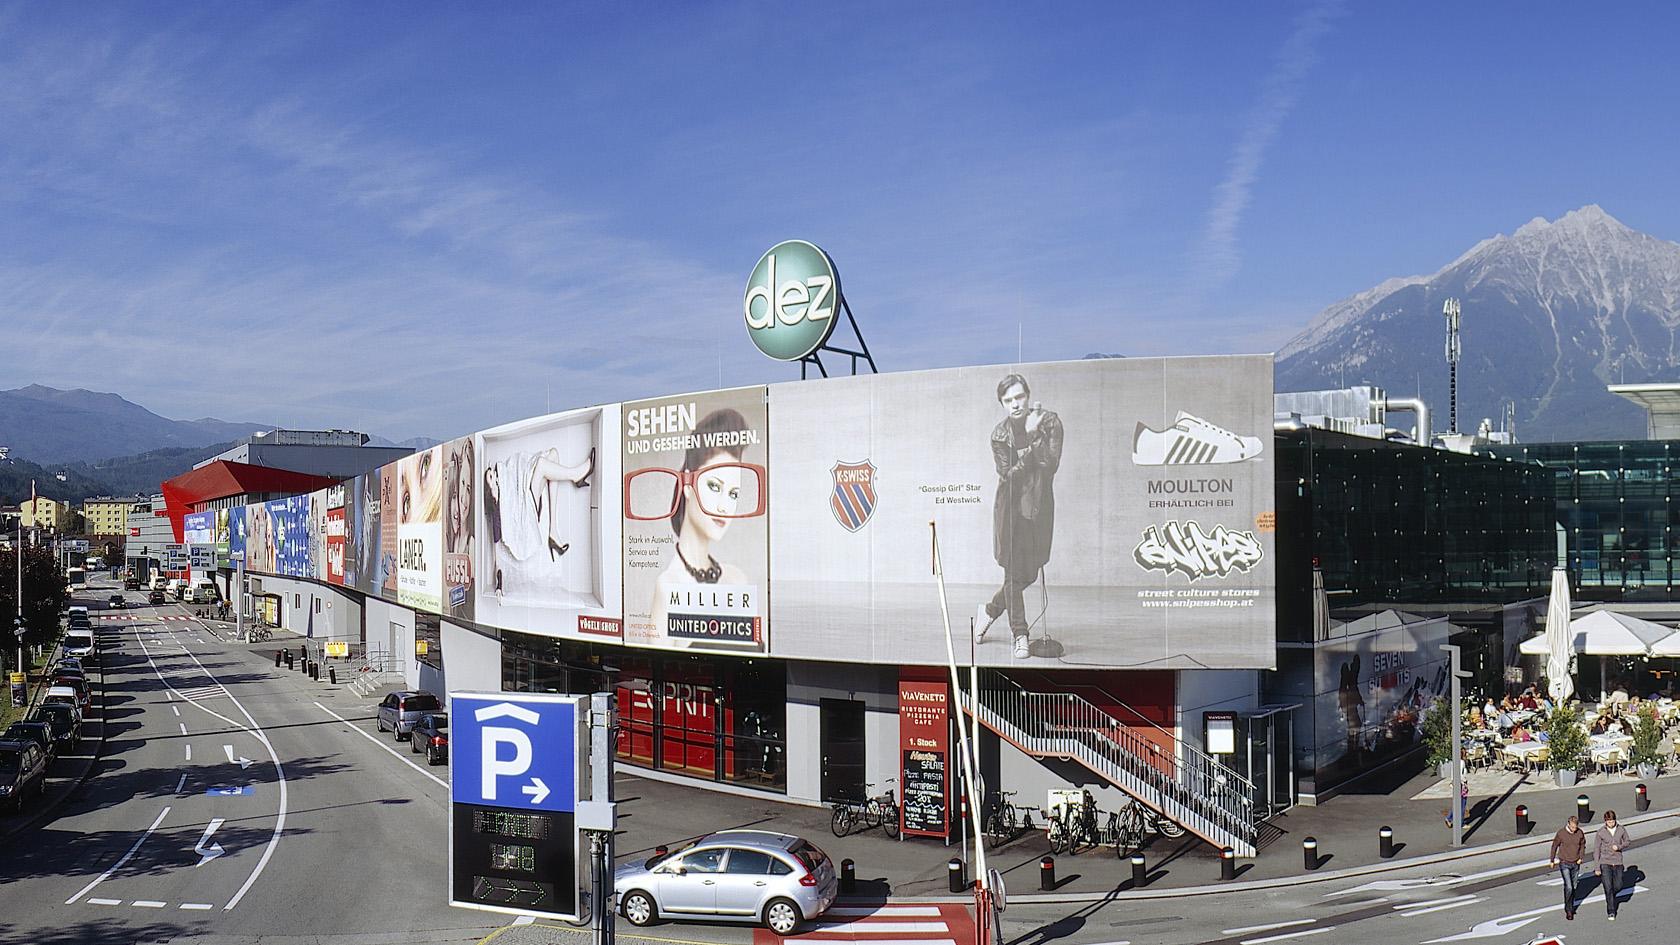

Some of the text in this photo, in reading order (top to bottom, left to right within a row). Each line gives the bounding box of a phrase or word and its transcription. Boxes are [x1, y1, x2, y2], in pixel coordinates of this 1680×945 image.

[745, 254, 832, 330] dez
[627, 402, 697, 437] SEHEN
[628, 430, 760, 454] UND GESEHEN WERDEN.
[965, 483, 981, 492] Star
[1147, 479, 1233, 494] MOULTON
[935, 496, 982, 504] Ed Westwick
[1149, 499, 1234, 508] ERHÄLTLICH BEI
[628, 534, 644, 544] Stark
[628, 546, 660, 556] Service und
[1137, 588, 1260, 598] street culture stores
[670, 592, 750, 608] MILLER
[1142, 598, 1254, 608] www.snipesshop.at
[601, 621, 619, 633] SHOES
[1374, 650, 1404, 672] SEVEN
[901, 705, 946, 714] RISTORANTE
[906, 712, 940, 720] PIZZERIA
[909, 737, 937, 747] 1. Stock
[481, 726, 533, 801] P
